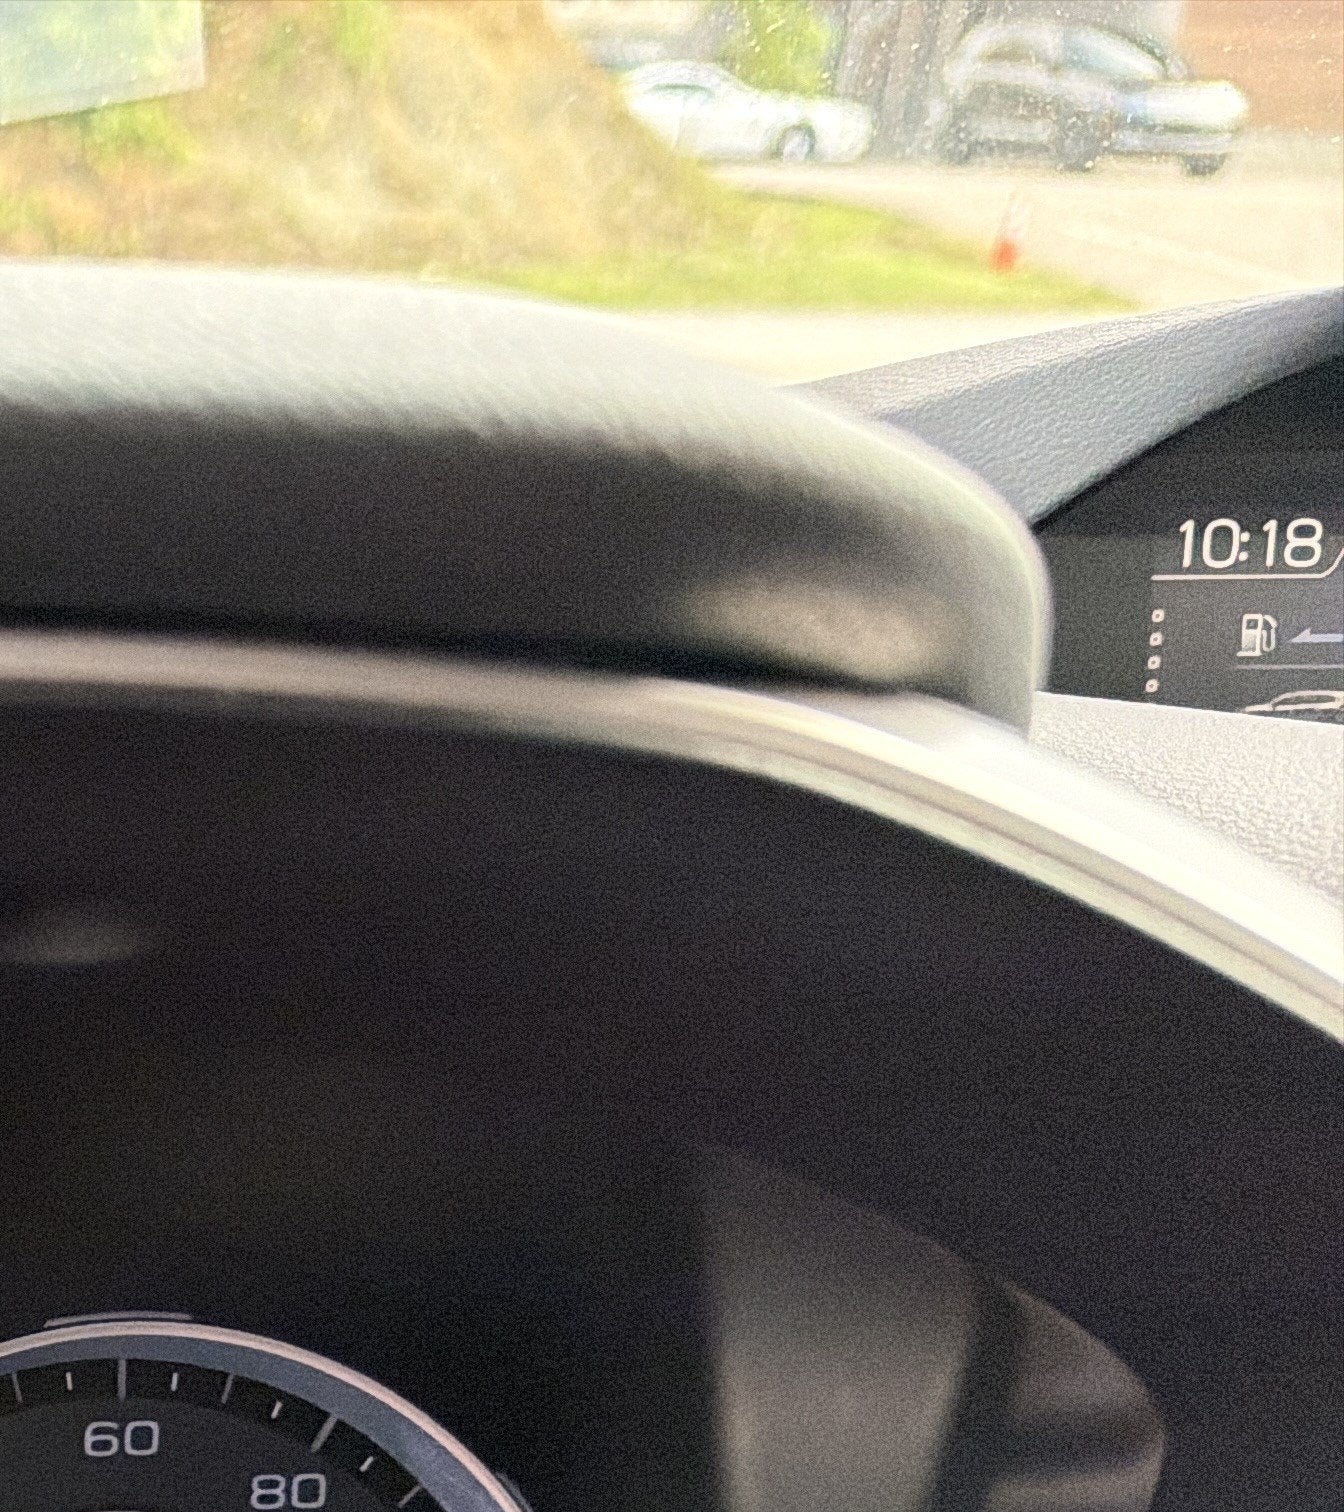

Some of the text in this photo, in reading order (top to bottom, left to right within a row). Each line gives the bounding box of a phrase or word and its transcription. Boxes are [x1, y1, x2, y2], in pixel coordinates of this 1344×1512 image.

[1179, 517, 1324, 568] 10:18
[84, 1421, 159, 1457] 60
[250, 1473, 326, 1510] 80
